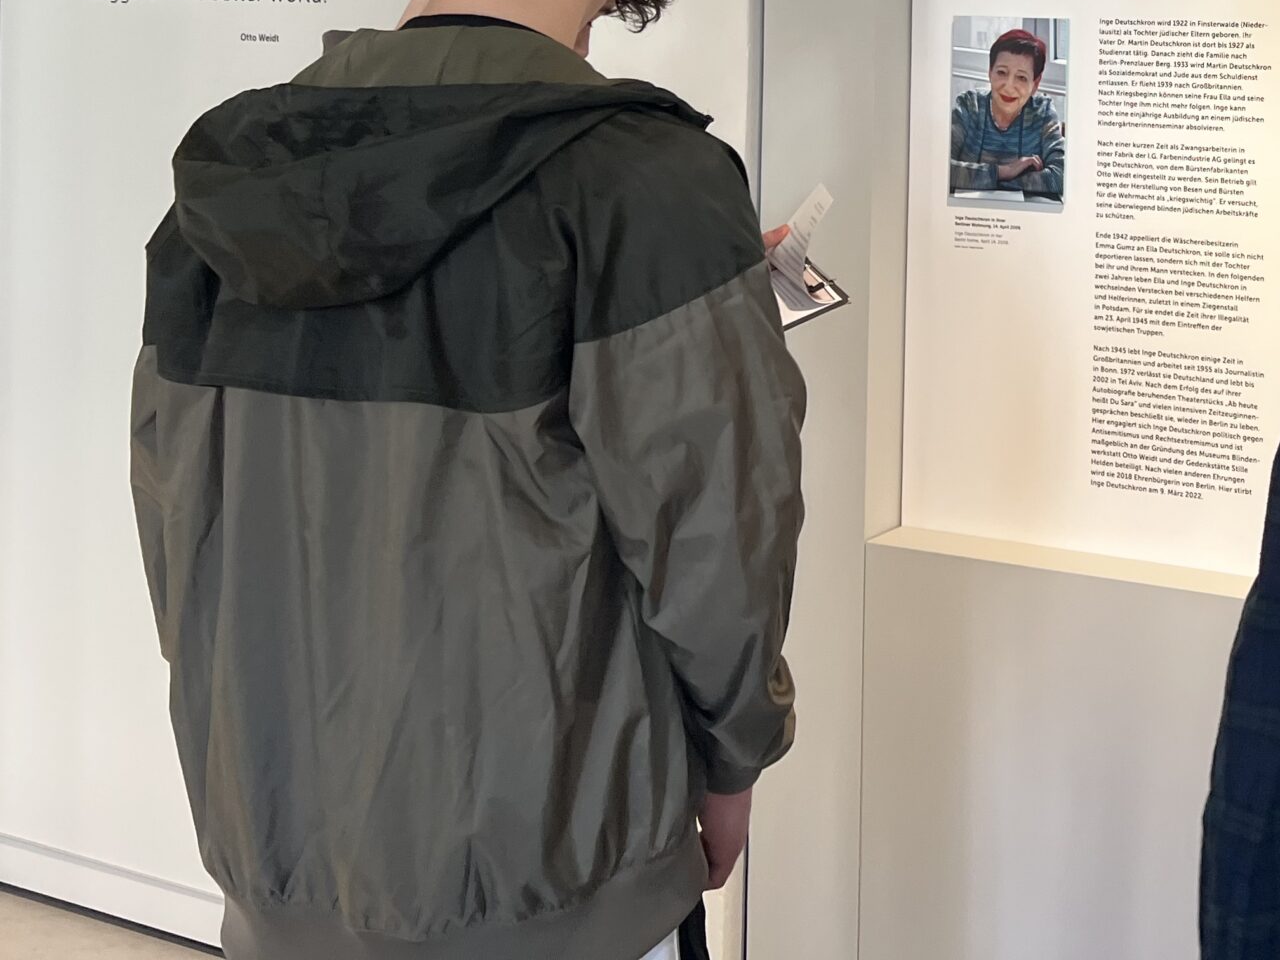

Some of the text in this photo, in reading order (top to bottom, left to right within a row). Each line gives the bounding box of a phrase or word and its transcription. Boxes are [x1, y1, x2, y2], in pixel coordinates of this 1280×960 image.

[1099, 17, 1113, 26] Inge
[1114, 18, 1155, 26] Deutschkron
[1197, 20, 1239, 28] Finsterwalde
[1240, 21, 1269, 29] (Nieder-
[240, 33, 279, 42] Otto Weidt
[1150, 39, 1191, 47] Deutschkron
[1228, 41, 1243, 49] 1927
[1099, 48, 1131, 56] Studienrat
[1176, 50, 1192, 58] zieht
[1206, 51, 1229, 59] Familie
[1099, 58, 1153, 66] Berlin-Prenzlauer
[1173, 60, 1188, 68] 1933
[1206, 61, 1227, 69] Martin
[1229, 62, 1272, 70] Deutschkron
[1108, 69, 1157, 77] Sozialdemokrat
[1219, 72, 1258, 80] Schuldienst
[1157, 80, 1172, 88] 1939
[1115, 89, 1157, 99] Kriegsbeginn
[1158, 91, 1183, 99] können
[1247, 94, 1264, 102] seine
